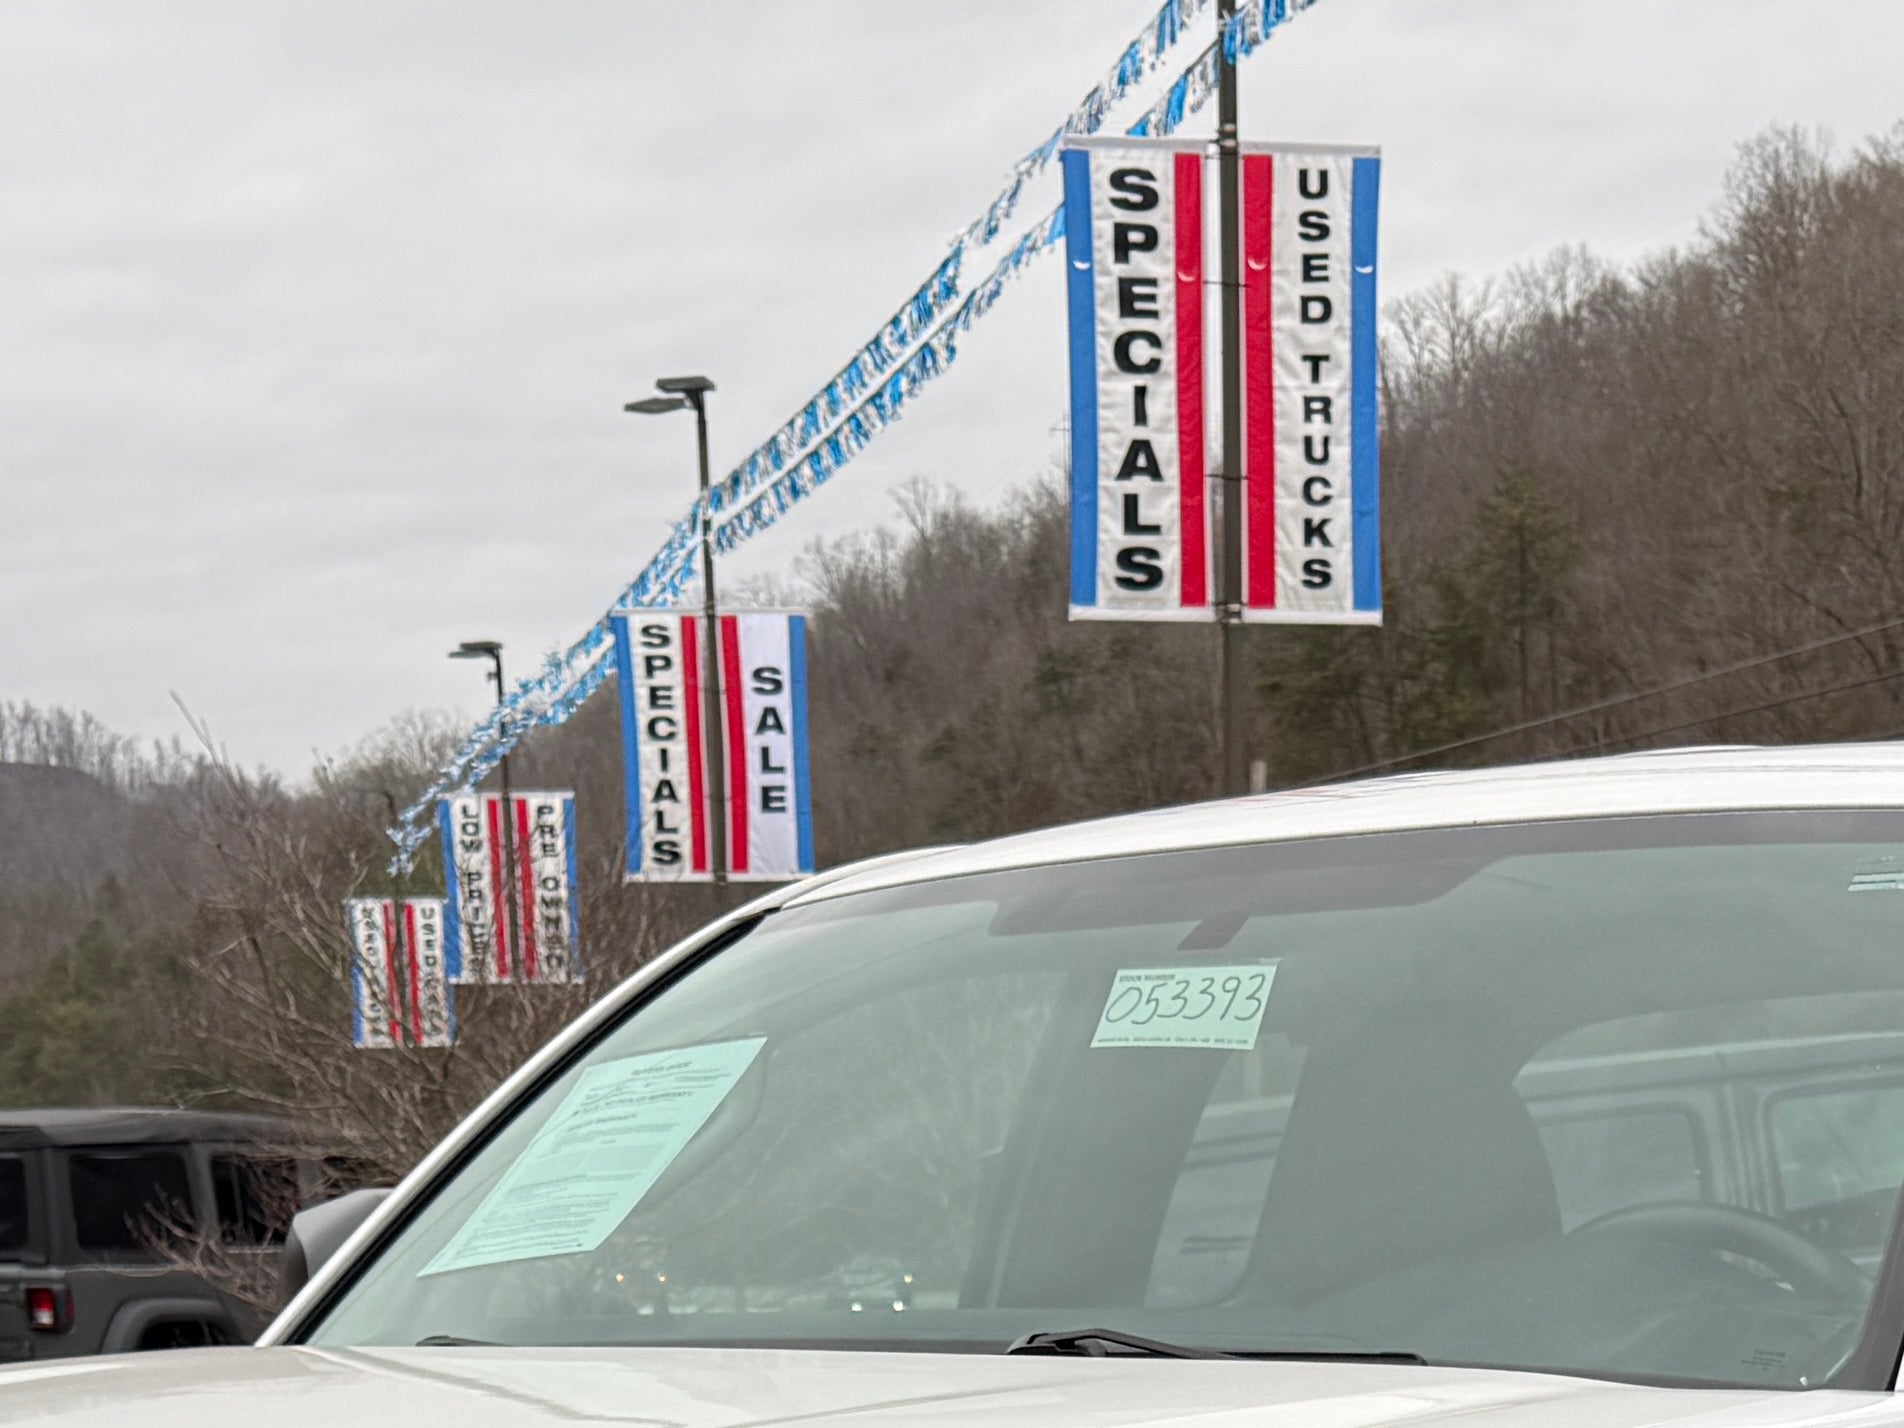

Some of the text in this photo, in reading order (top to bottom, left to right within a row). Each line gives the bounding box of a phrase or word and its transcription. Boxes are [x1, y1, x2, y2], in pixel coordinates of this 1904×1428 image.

[1109, 167, 1164, 591] SPECIALS
[1298, 168, 1335, 590] USED TRUCKS
[640, 624, 682, 865] SPECIALS
[752, 666, 787, 814] SALE
[460, 805, 482, 853] LOW
[421, 907, 438, 967] USED
[1105, 973, 1266, 1025] 053393
